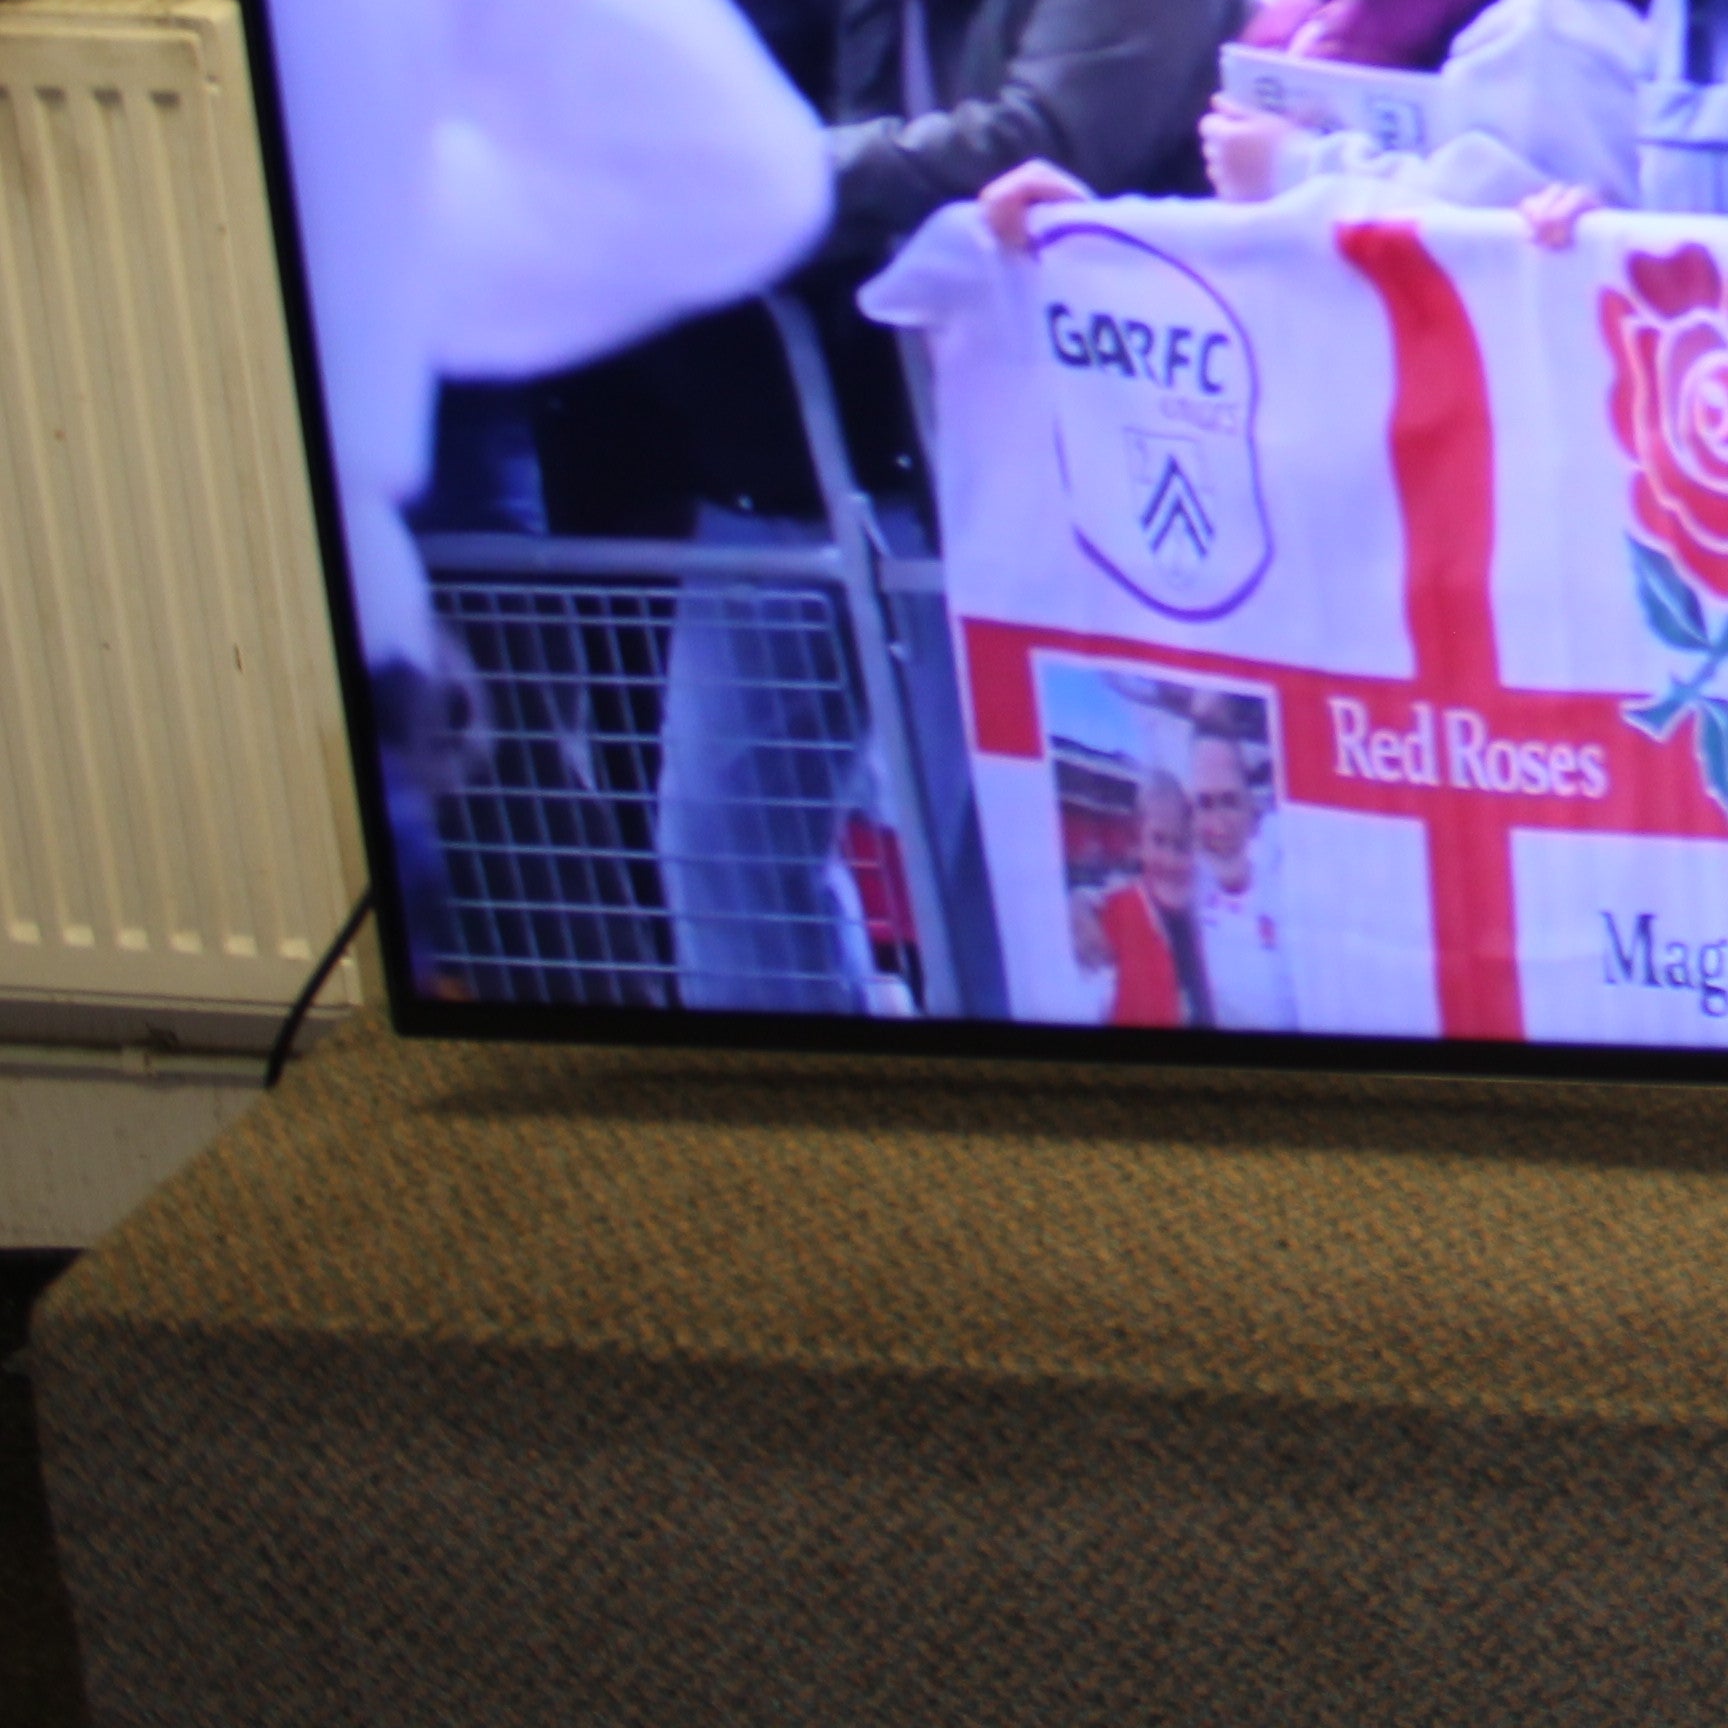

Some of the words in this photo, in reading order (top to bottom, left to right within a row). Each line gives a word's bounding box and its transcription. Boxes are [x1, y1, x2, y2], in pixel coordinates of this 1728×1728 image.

[1048, 302, 1229, 394] GARFC
[1328, 696, 1440, 786] Red
[1443, 707, 1608, 799] Roses
